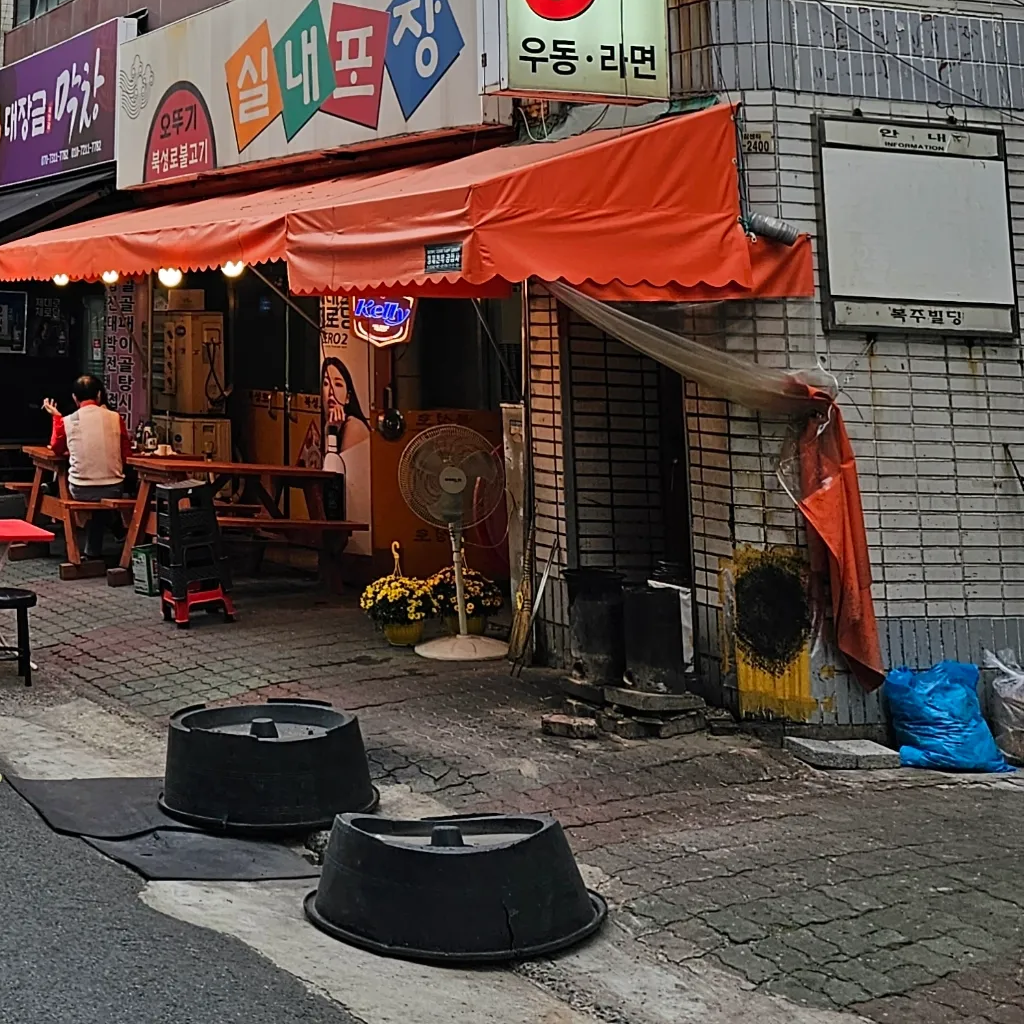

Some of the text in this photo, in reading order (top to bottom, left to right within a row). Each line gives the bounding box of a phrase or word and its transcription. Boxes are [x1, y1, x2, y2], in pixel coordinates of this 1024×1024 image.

[4, 90, 46, 142] 대장금
[160, 103, 197, 139] 오뚜기
[151, 138, 208, 174] 북성로불고기
[884, 141, 945, 151] INFORMATION
[354, 299, 411, 327] Kelly
